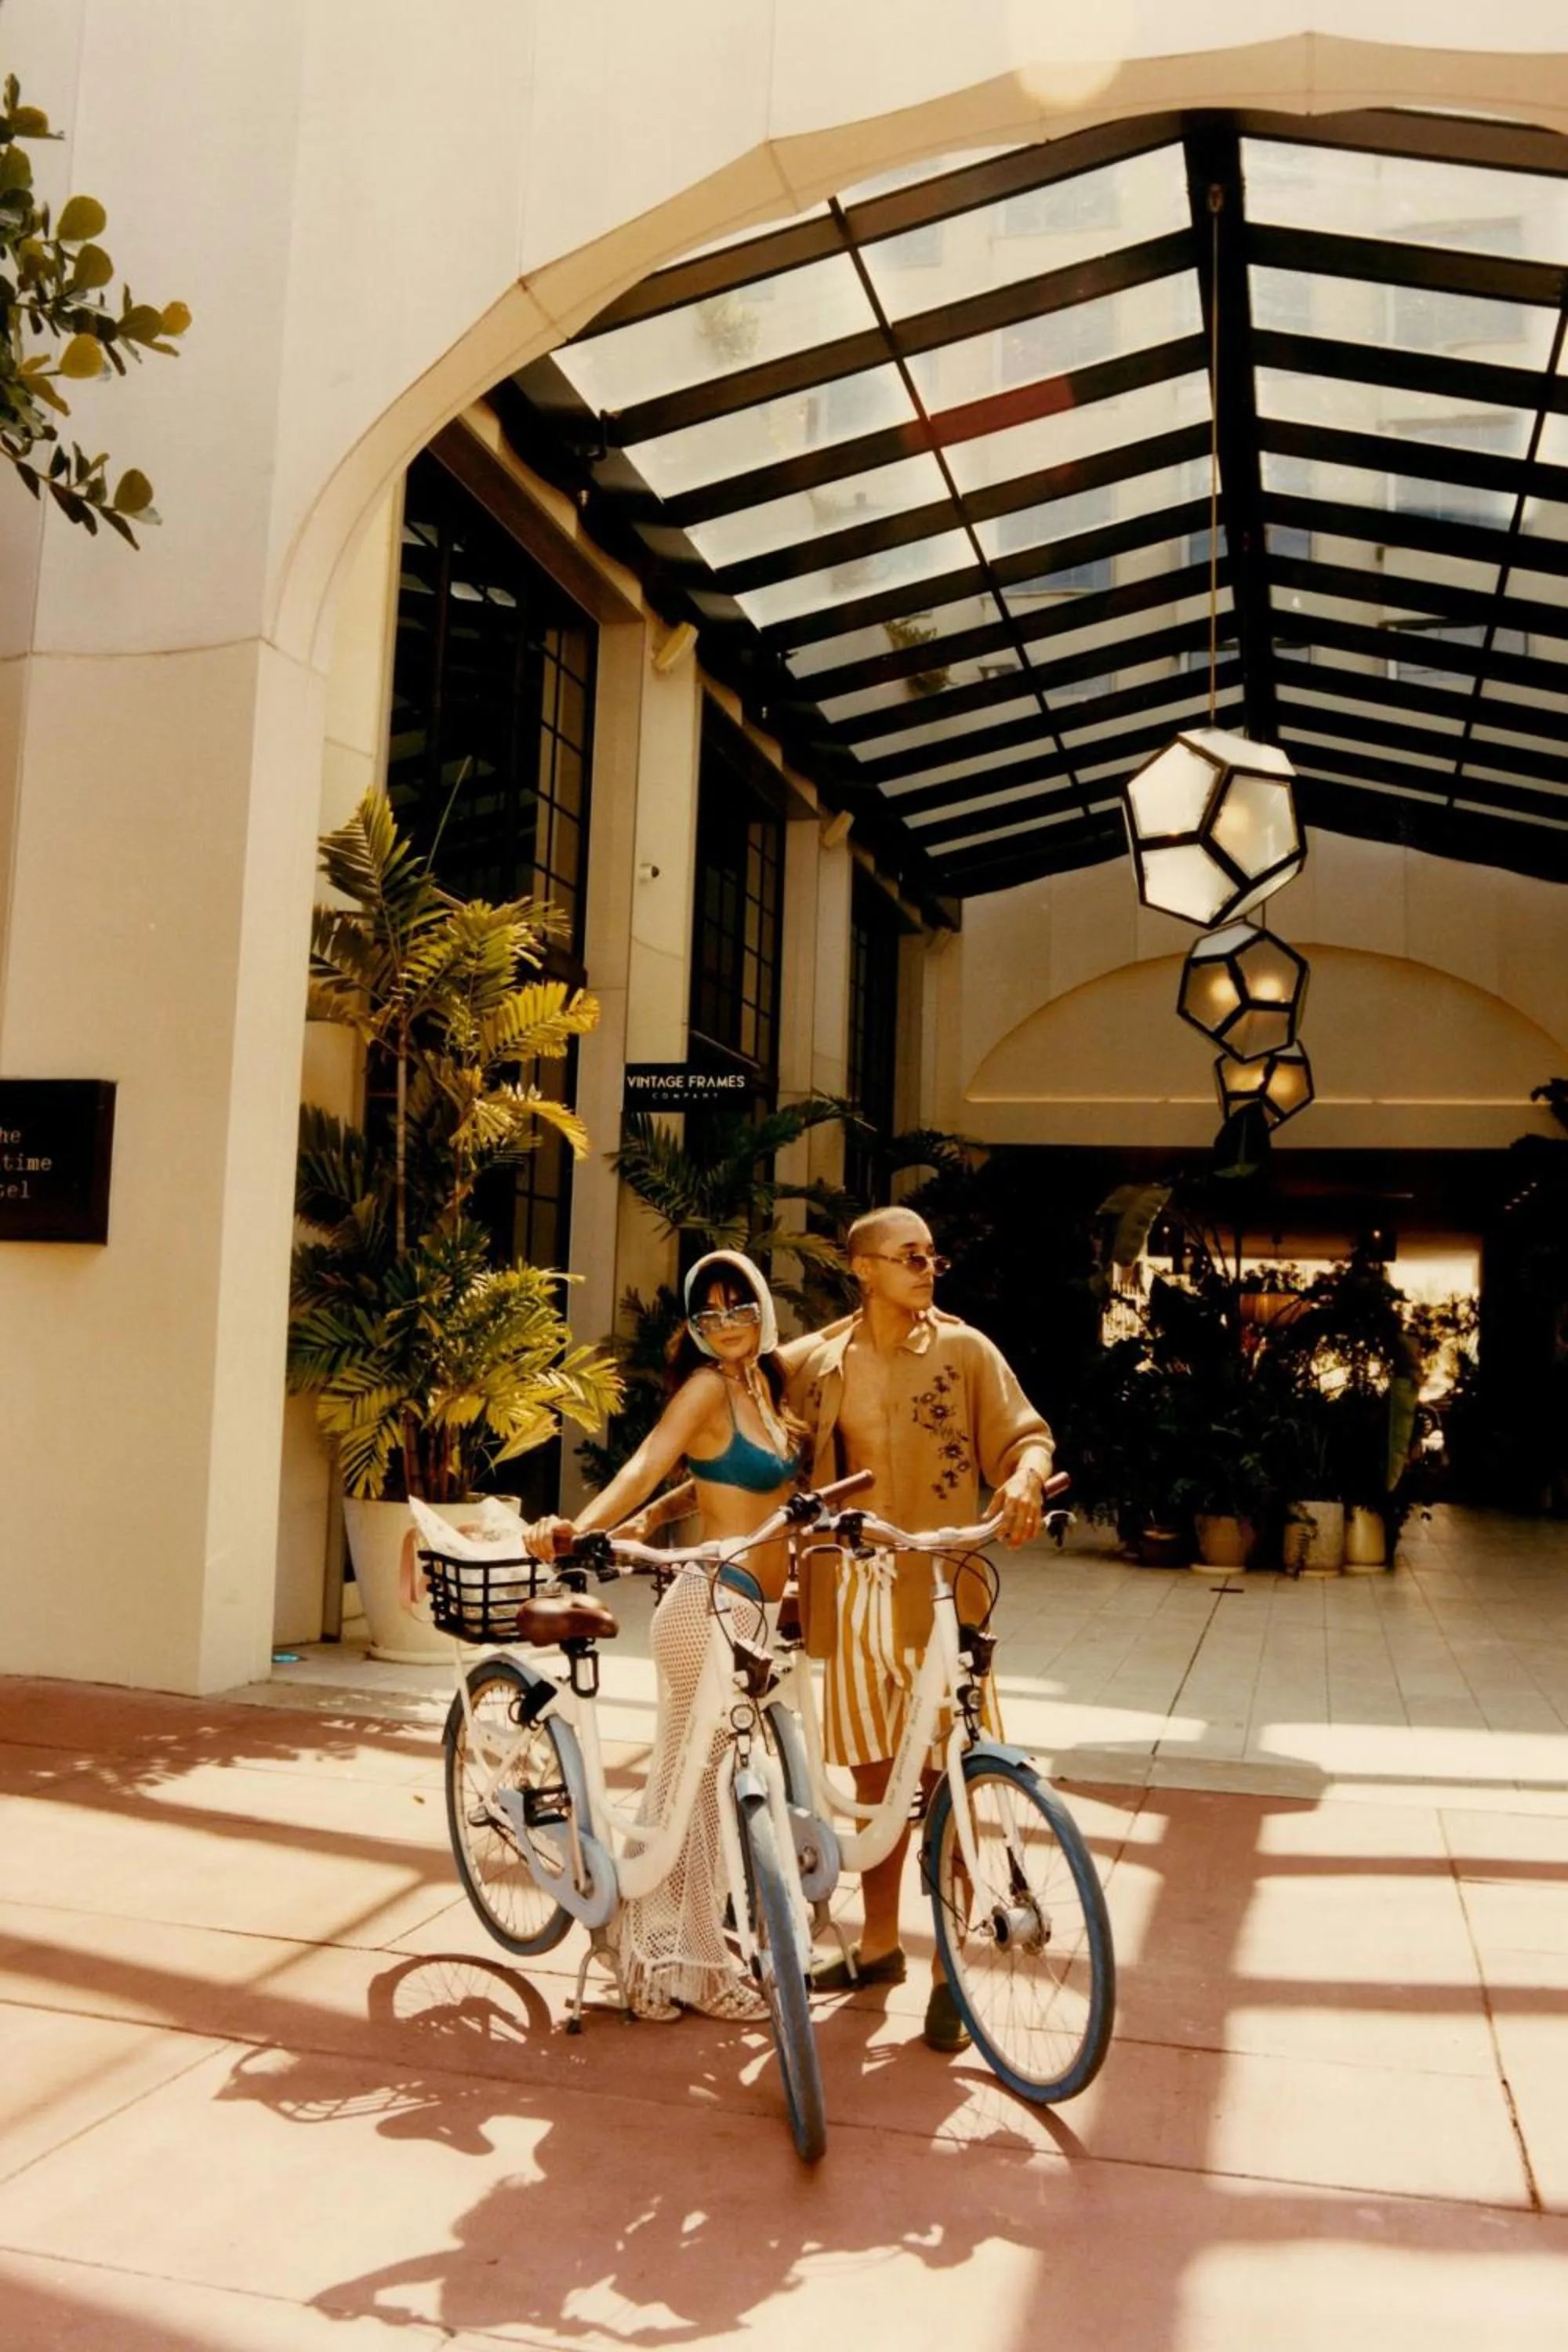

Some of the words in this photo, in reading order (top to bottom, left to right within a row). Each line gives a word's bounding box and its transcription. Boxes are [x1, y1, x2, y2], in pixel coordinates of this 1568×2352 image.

[627, 1076, 684, 1088] VINTAGE
[688, 1075, 745, 1088] FRAMES
[0, 1152, 53, 1171] time
